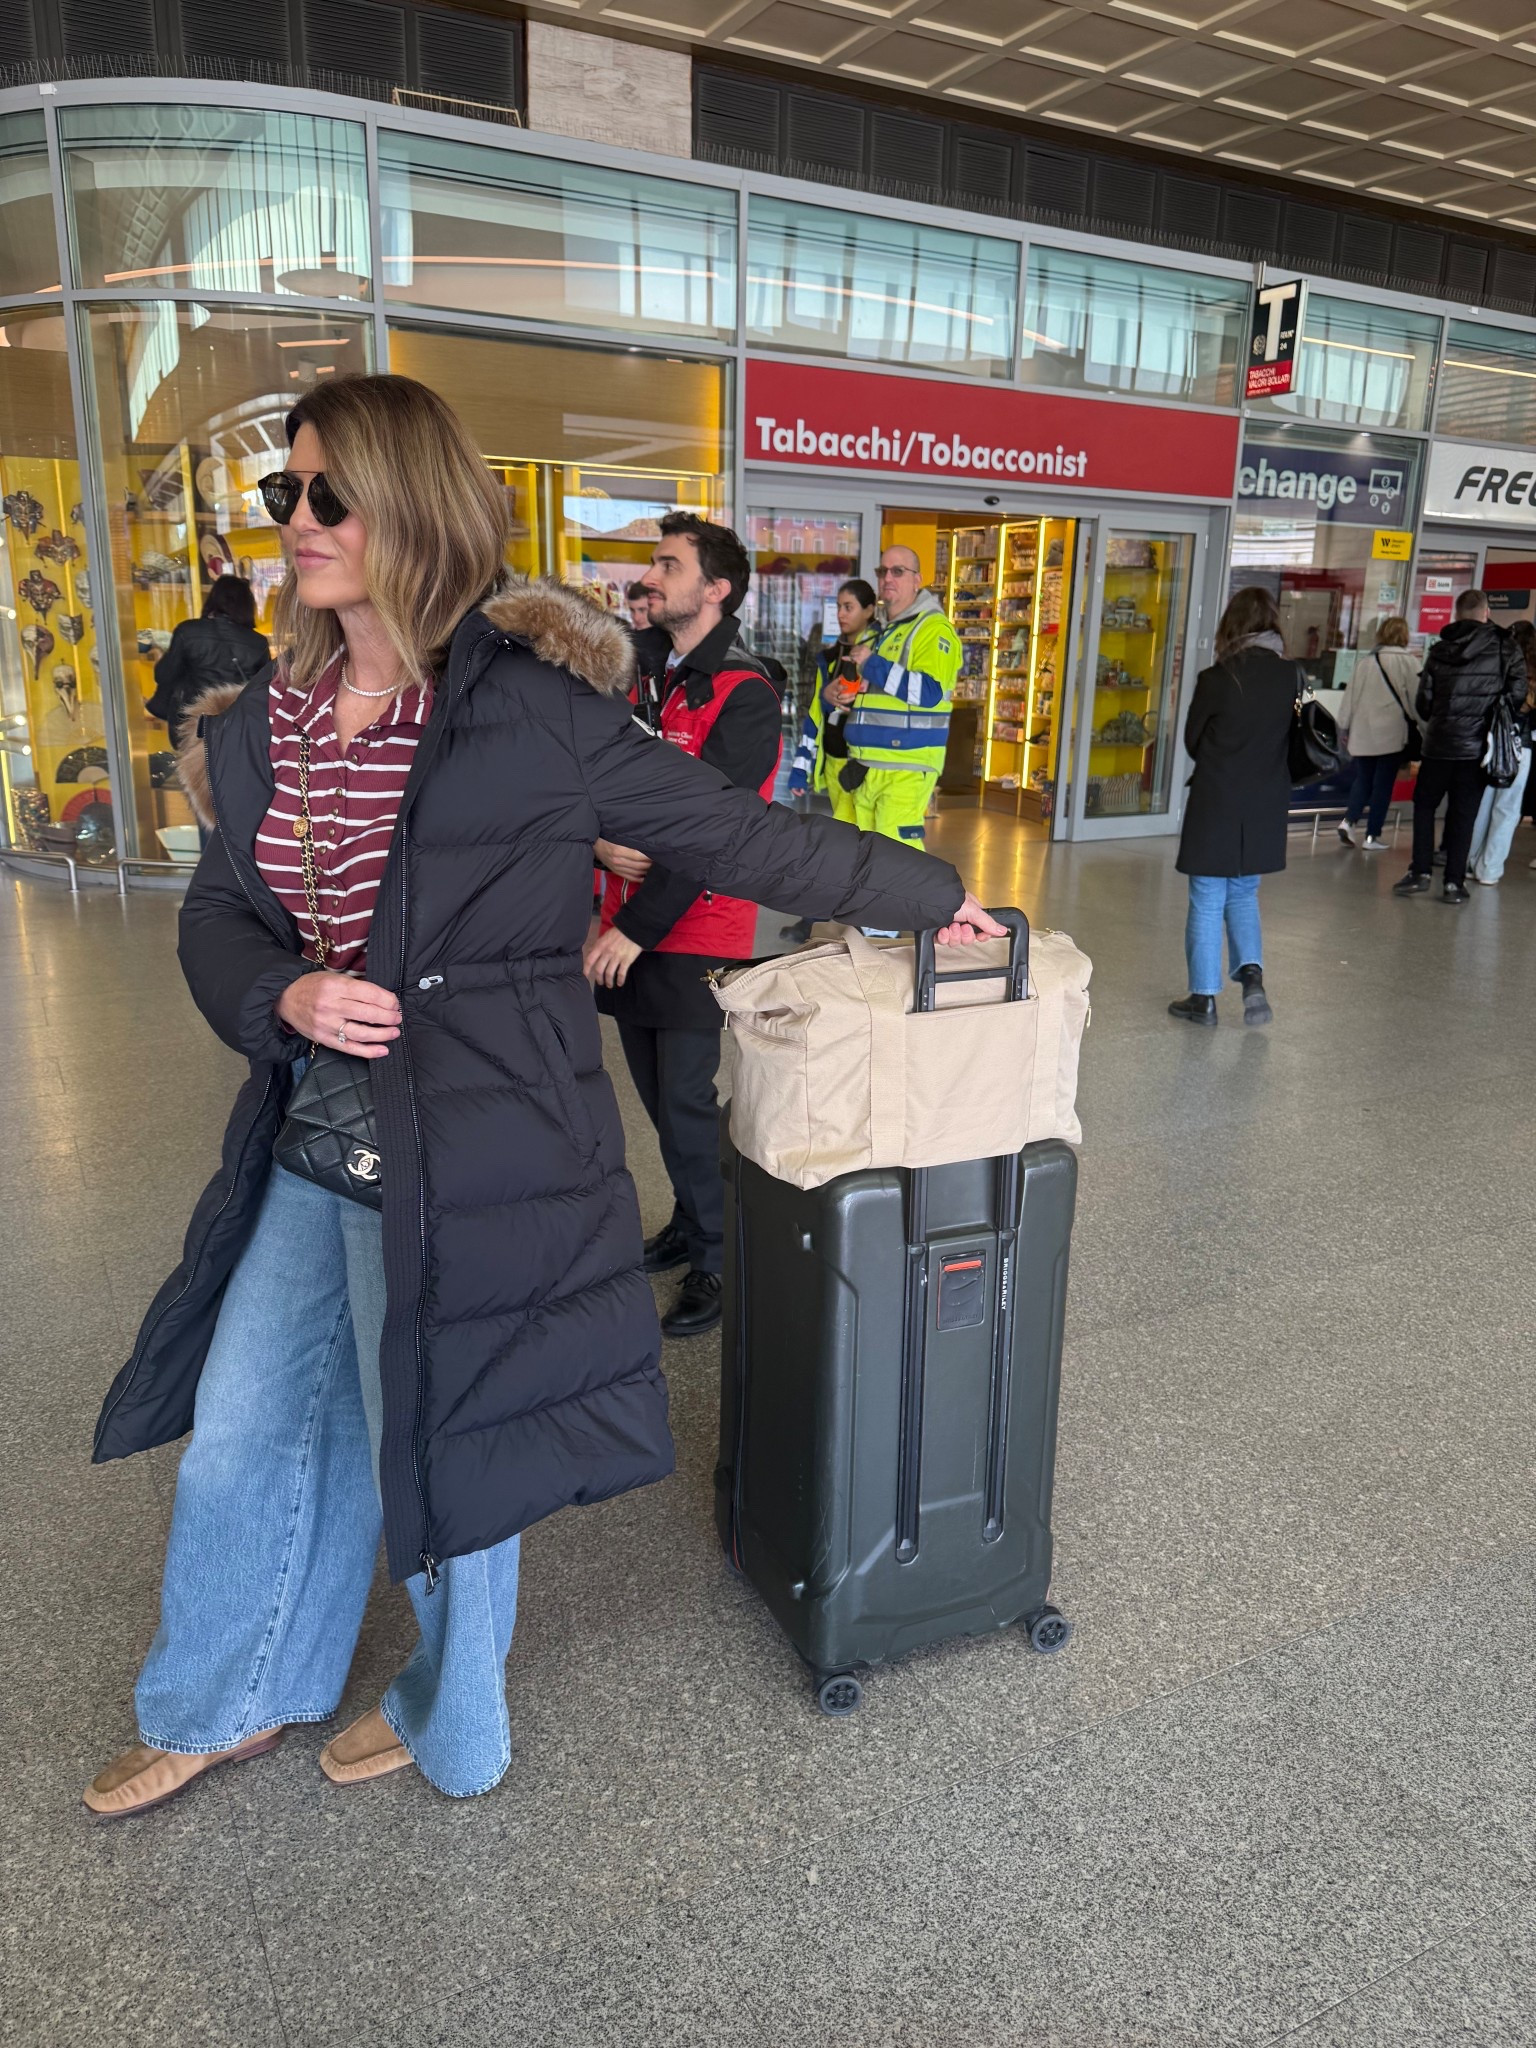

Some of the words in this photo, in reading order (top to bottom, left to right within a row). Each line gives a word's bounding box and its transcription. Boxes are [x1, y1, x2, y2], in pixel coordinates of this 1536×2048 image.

[1259, 283, 1297, 361] T
[1248, 378, 1267, 389] VALORI
[1268, 373, 1291, 387] BOLLATI
[1249, 367, 1276, 380] TABACCHI
[755, 416, 1088, 478] Tabacchi/Tobacconist
[1238, 458, 1357, 510] change
[1001, 1258, 1009, 1310] BRIGGS&RILEY
